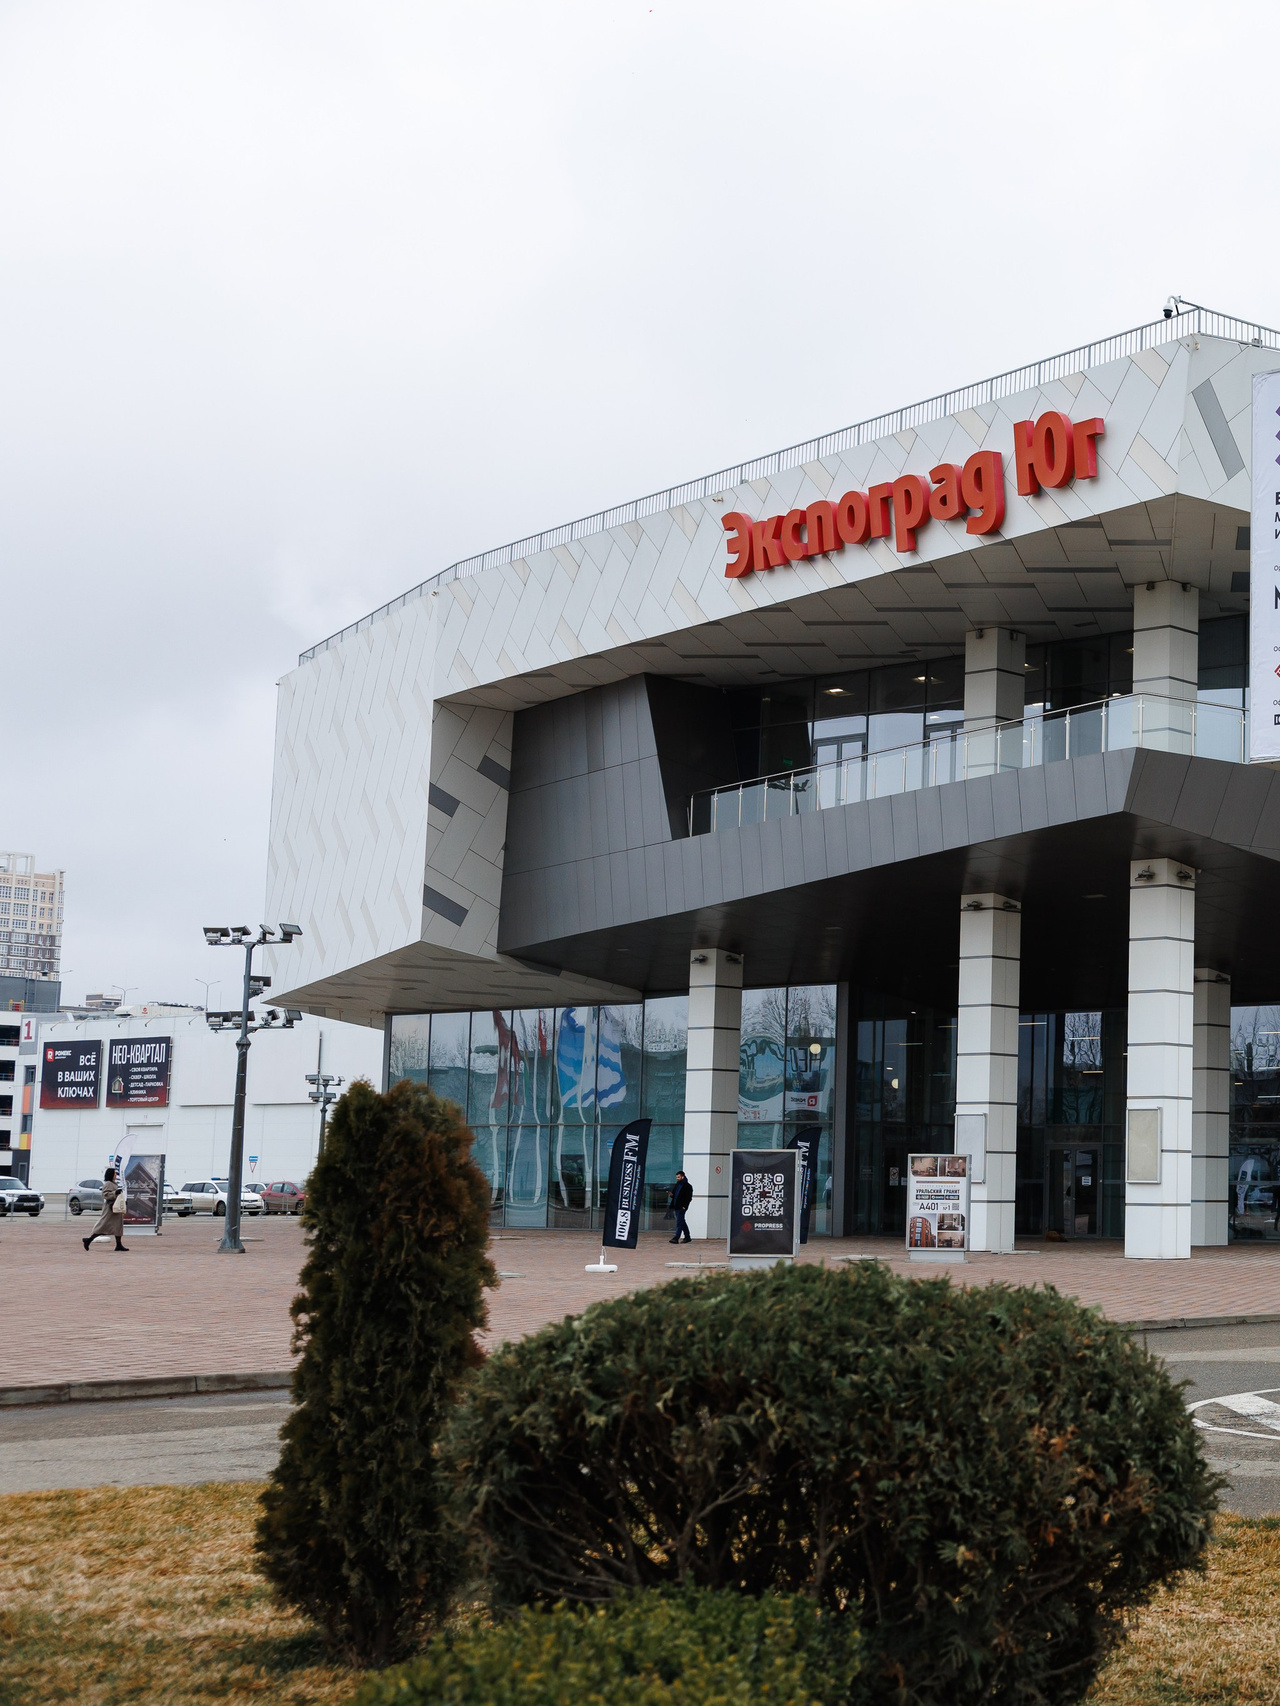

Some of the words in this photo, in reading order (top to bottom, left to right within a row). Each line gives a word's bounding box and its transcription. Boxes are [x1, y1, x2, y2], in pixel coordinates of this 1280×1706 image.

[720, 450, 1006, 579] Экспоград
[1013, 410, 1105, 497] Юг
[24, 1020, 33, 1040] 1
[79, 1052, 96, 1066] ВСЁ
[112, 1043, 166, 1065] НЕО-КВАРТАЛ
[57, 1072, 64, 1082] В
[64, 1071, 95, 1082] ВАШИХ
[57, 1087, 95, 1098] КЛЮЧАХ
[623, 1133, 640, 1162] FM
[622, 1163, 633, 1209] BUSINESS
